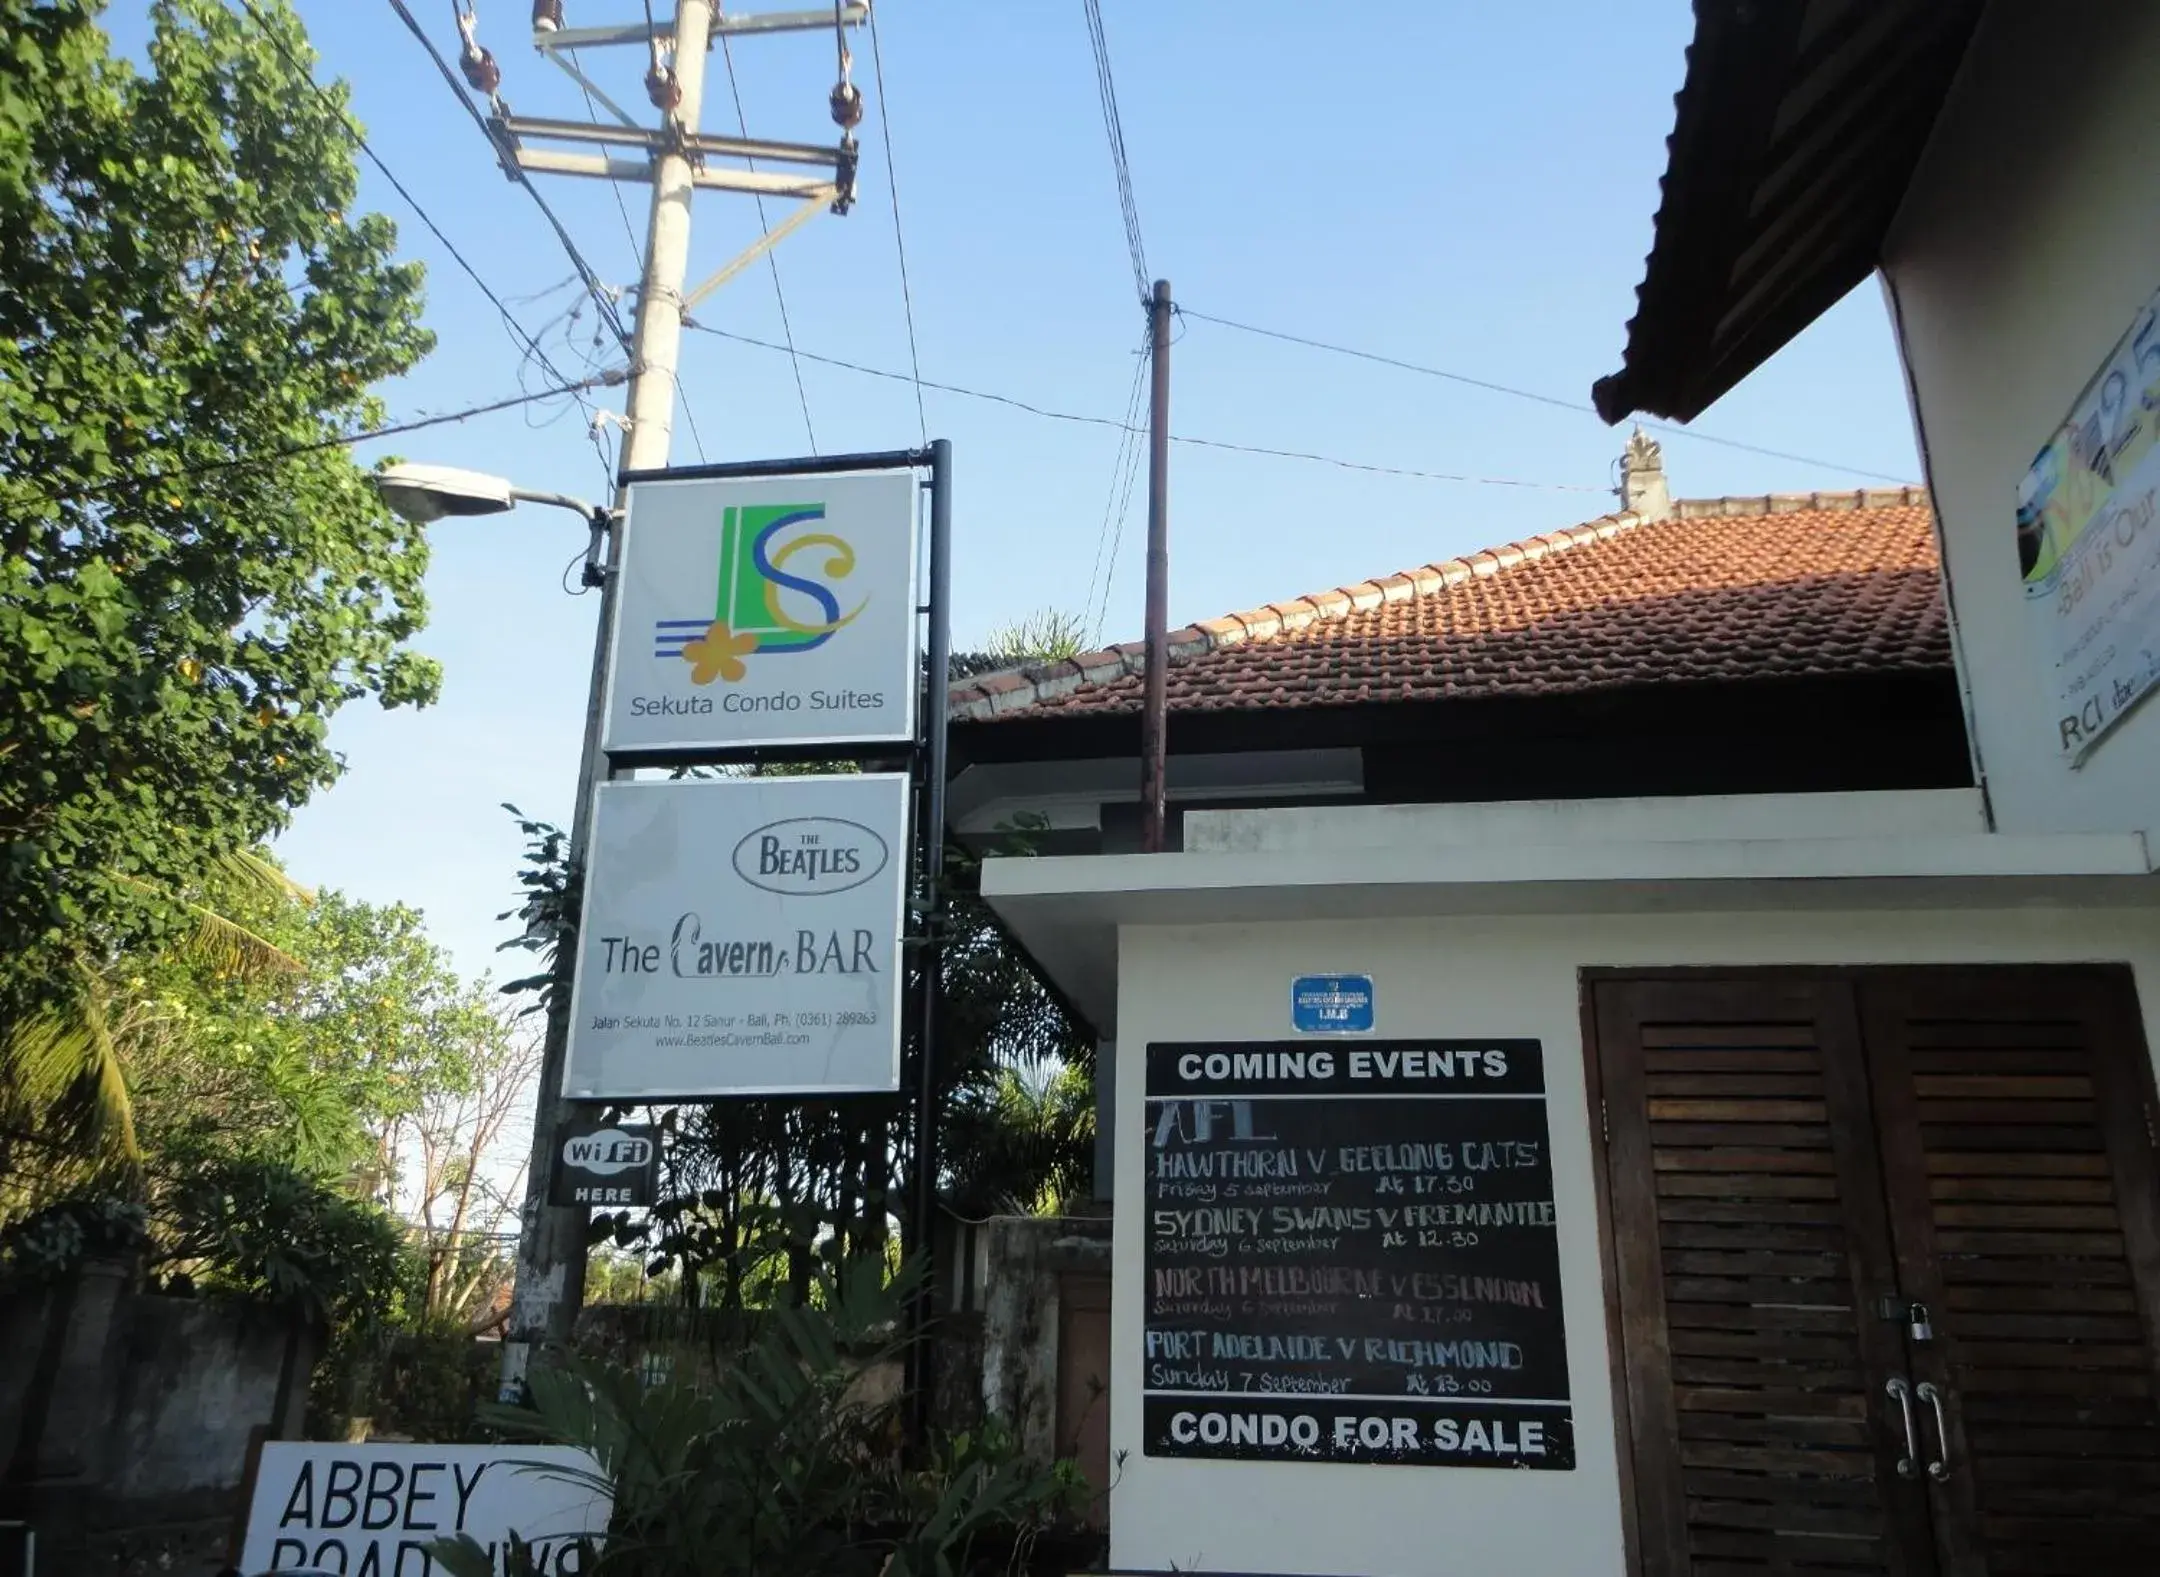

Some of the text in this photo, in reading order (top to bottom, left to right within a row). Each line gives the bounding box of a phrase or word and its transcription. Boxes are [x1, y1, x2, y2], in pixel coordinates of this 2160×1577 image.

[630, 690, 884, 716] Sekuta Condo Suites
[801, 835, 819, 845] THE
[759, 835, 860, 881] BEATLES
[601, 937, 660, 974] The
[795, 929, 880, 974] BAR
[592, 1016, 620, 1030] Jalan
[623, 1015, 660, 1029] Sekuta
[664, 1015, 682, 1028] No.
[687, 1014, 699, 1027] 12
[1178, 1050, 1508, 1081] COMING EVENTS
[1156, 1149, 1298, 1179] HAWTHORN
[1307, 1149, 1326, 1174] V
[1461, 1141, 1539, 1171] CATS
[575, 1187, 632, 1202] HERE
[1223, 1184, 1240, 1196] 5
[1154, 1207, 1263, 1237] SYDNEY
[1273, 1206, 1371, 1233] SWANS
[1376, 1207, 1398, 1228] V
[1155, 1266, 1235, 1298] NORTH
[1146, 1330, 1207, 1360] PORT
[1212, 1331, 1332, 1361] ADELAIDE
[1336, 1338, 1356, 1360] V
[1151, 1360, 1229, 1392] Sunday
[1239, 1372, 1254, 1392] 7
[1170, 1411, 1548, 1454] CONDO FOR SALE
[279, 1460, 487, 1531] ABBEY
